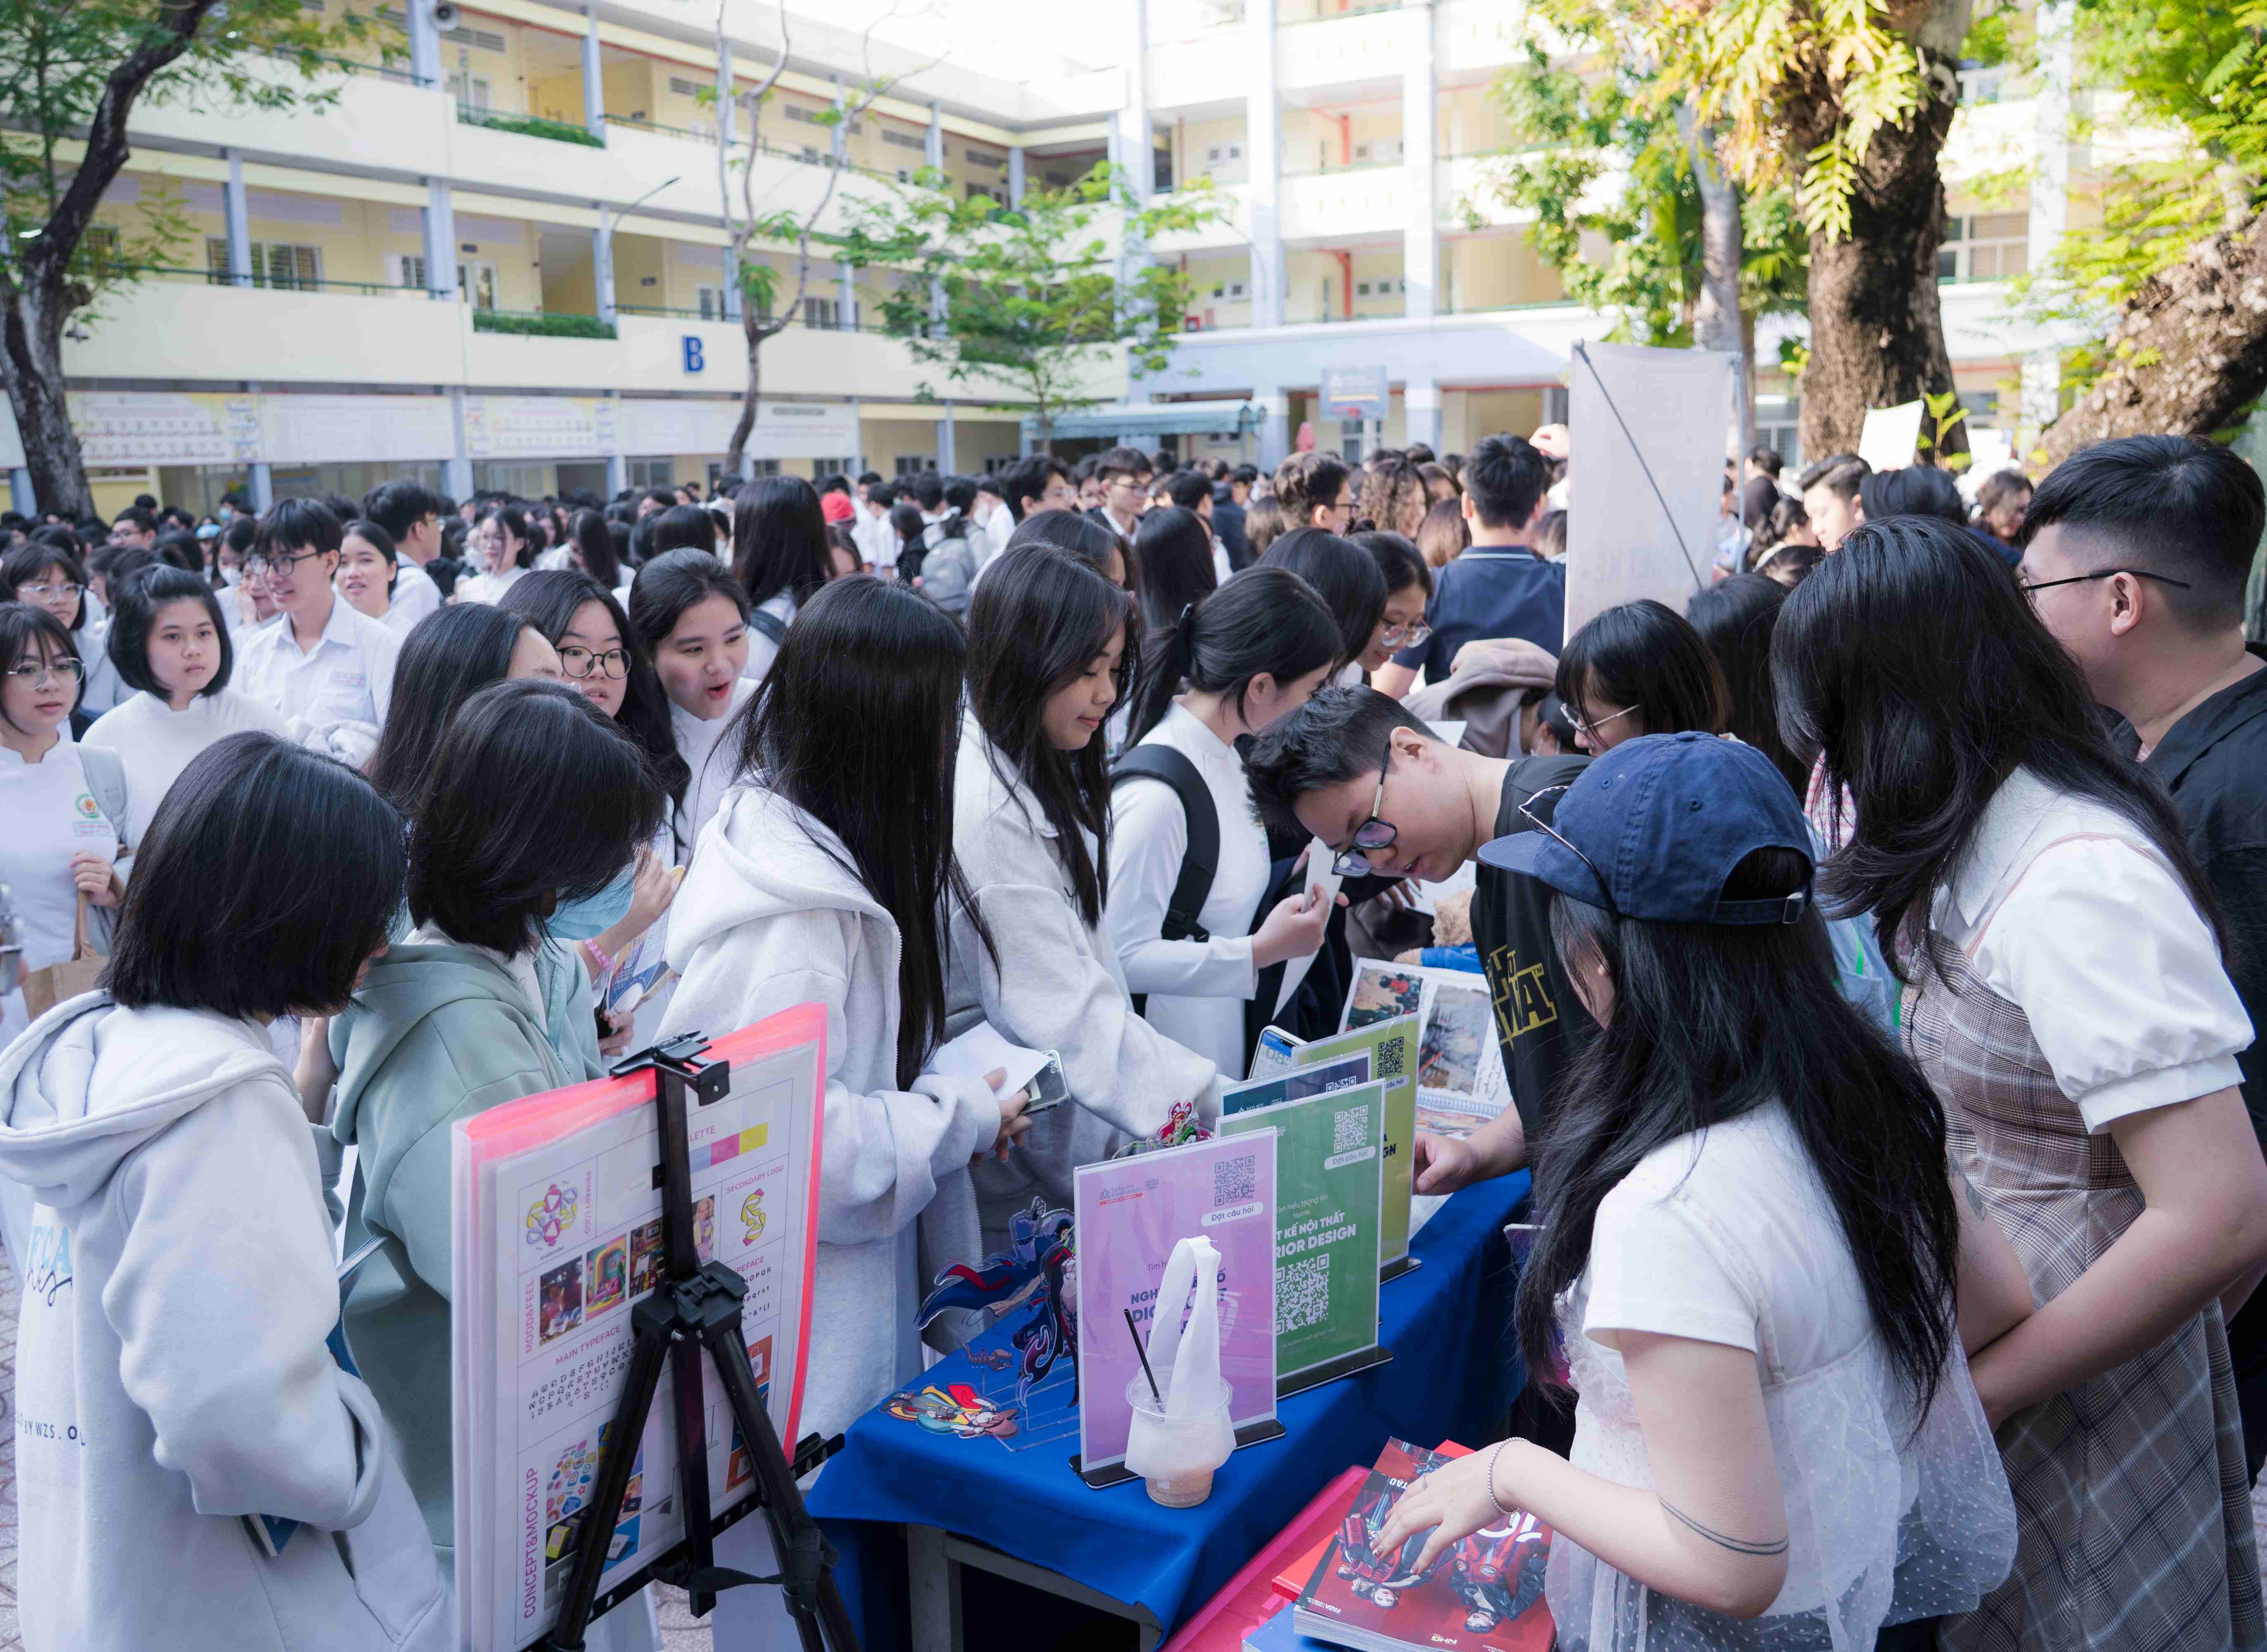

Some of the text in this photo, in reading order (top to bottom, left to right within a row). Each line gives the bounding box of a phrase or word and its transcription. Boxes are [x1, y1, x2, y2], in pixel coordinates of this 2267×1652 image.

[683, 335, 704, 373] B
[689, 1125, 715, 1142] LETTE
[726, 1165, 784, 1193] SECONDARY LOGO
[1211, 1205, 1254, 1222] Đặt câu hỏi
[1284, 1222, 1298, 1239] KẾ
[1299, 1219, 1317, 1234] NỘI
[1320, 1210, 1345, 1228] THẤT
[1308, 1223, 1356, 1249] DESIGN
[734, 1255, 765, 1273] PEFACE
[1131, 1285, 1161, 1304] NGH
[525, 1279, 534, 1354] MOOD&FEEL
[555, 1324, 622, 1365] MAIN TYPEFACE
[525, 1467, 539, 1619] CONCEPT&MOCKUP
[1325, 1604, 1341, 1614] FADA
